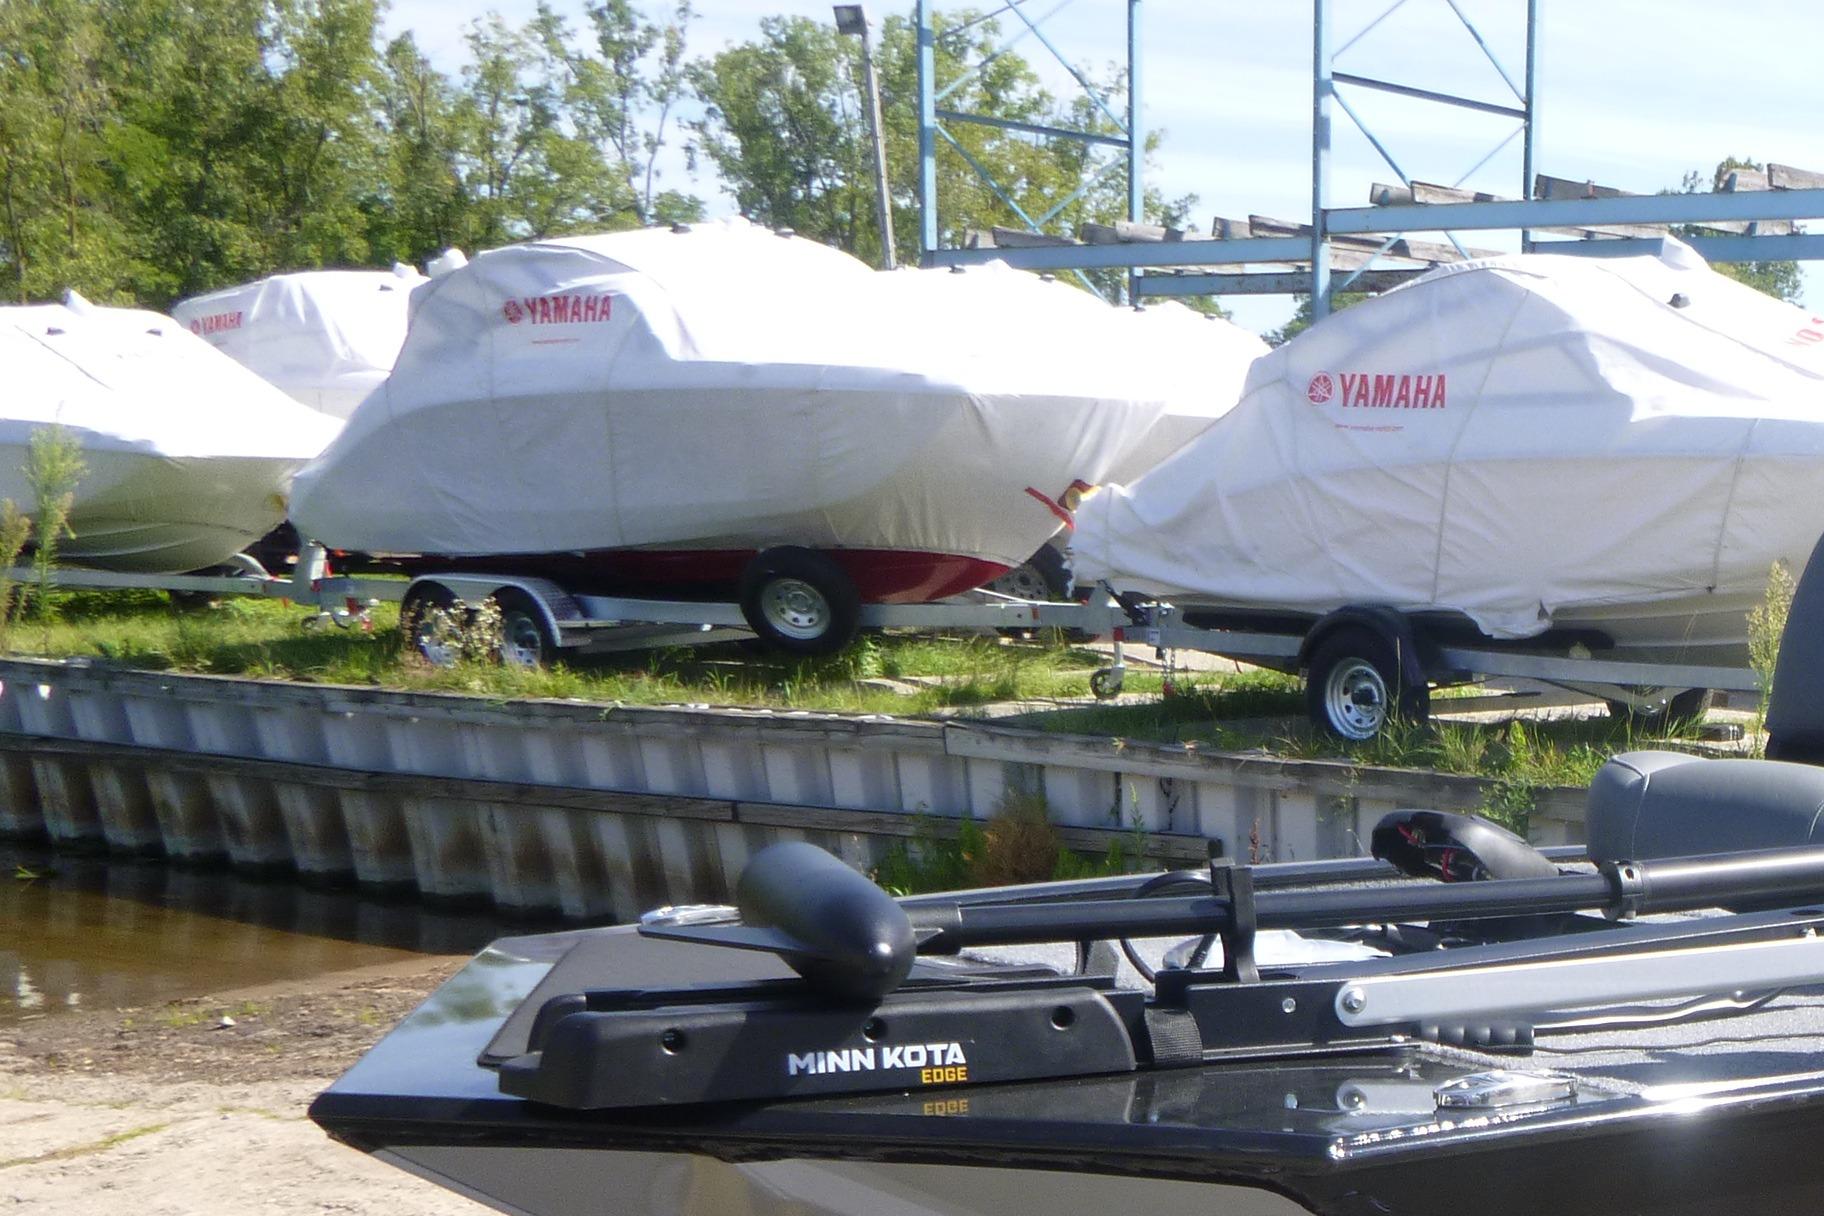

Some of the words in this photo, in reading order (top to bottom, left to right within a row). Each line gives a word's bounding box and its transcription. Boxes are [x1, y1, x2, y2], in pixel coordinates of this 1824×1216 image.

[524, 295, 611, 324] YAMAHA
[1340, 373, 1446, 408] YAMAHA
[788, 1048, 875, 1075] MINN
[883, 1043, 966, 1068] KOTA
[922, 1067, 967, 1083] EDGE
